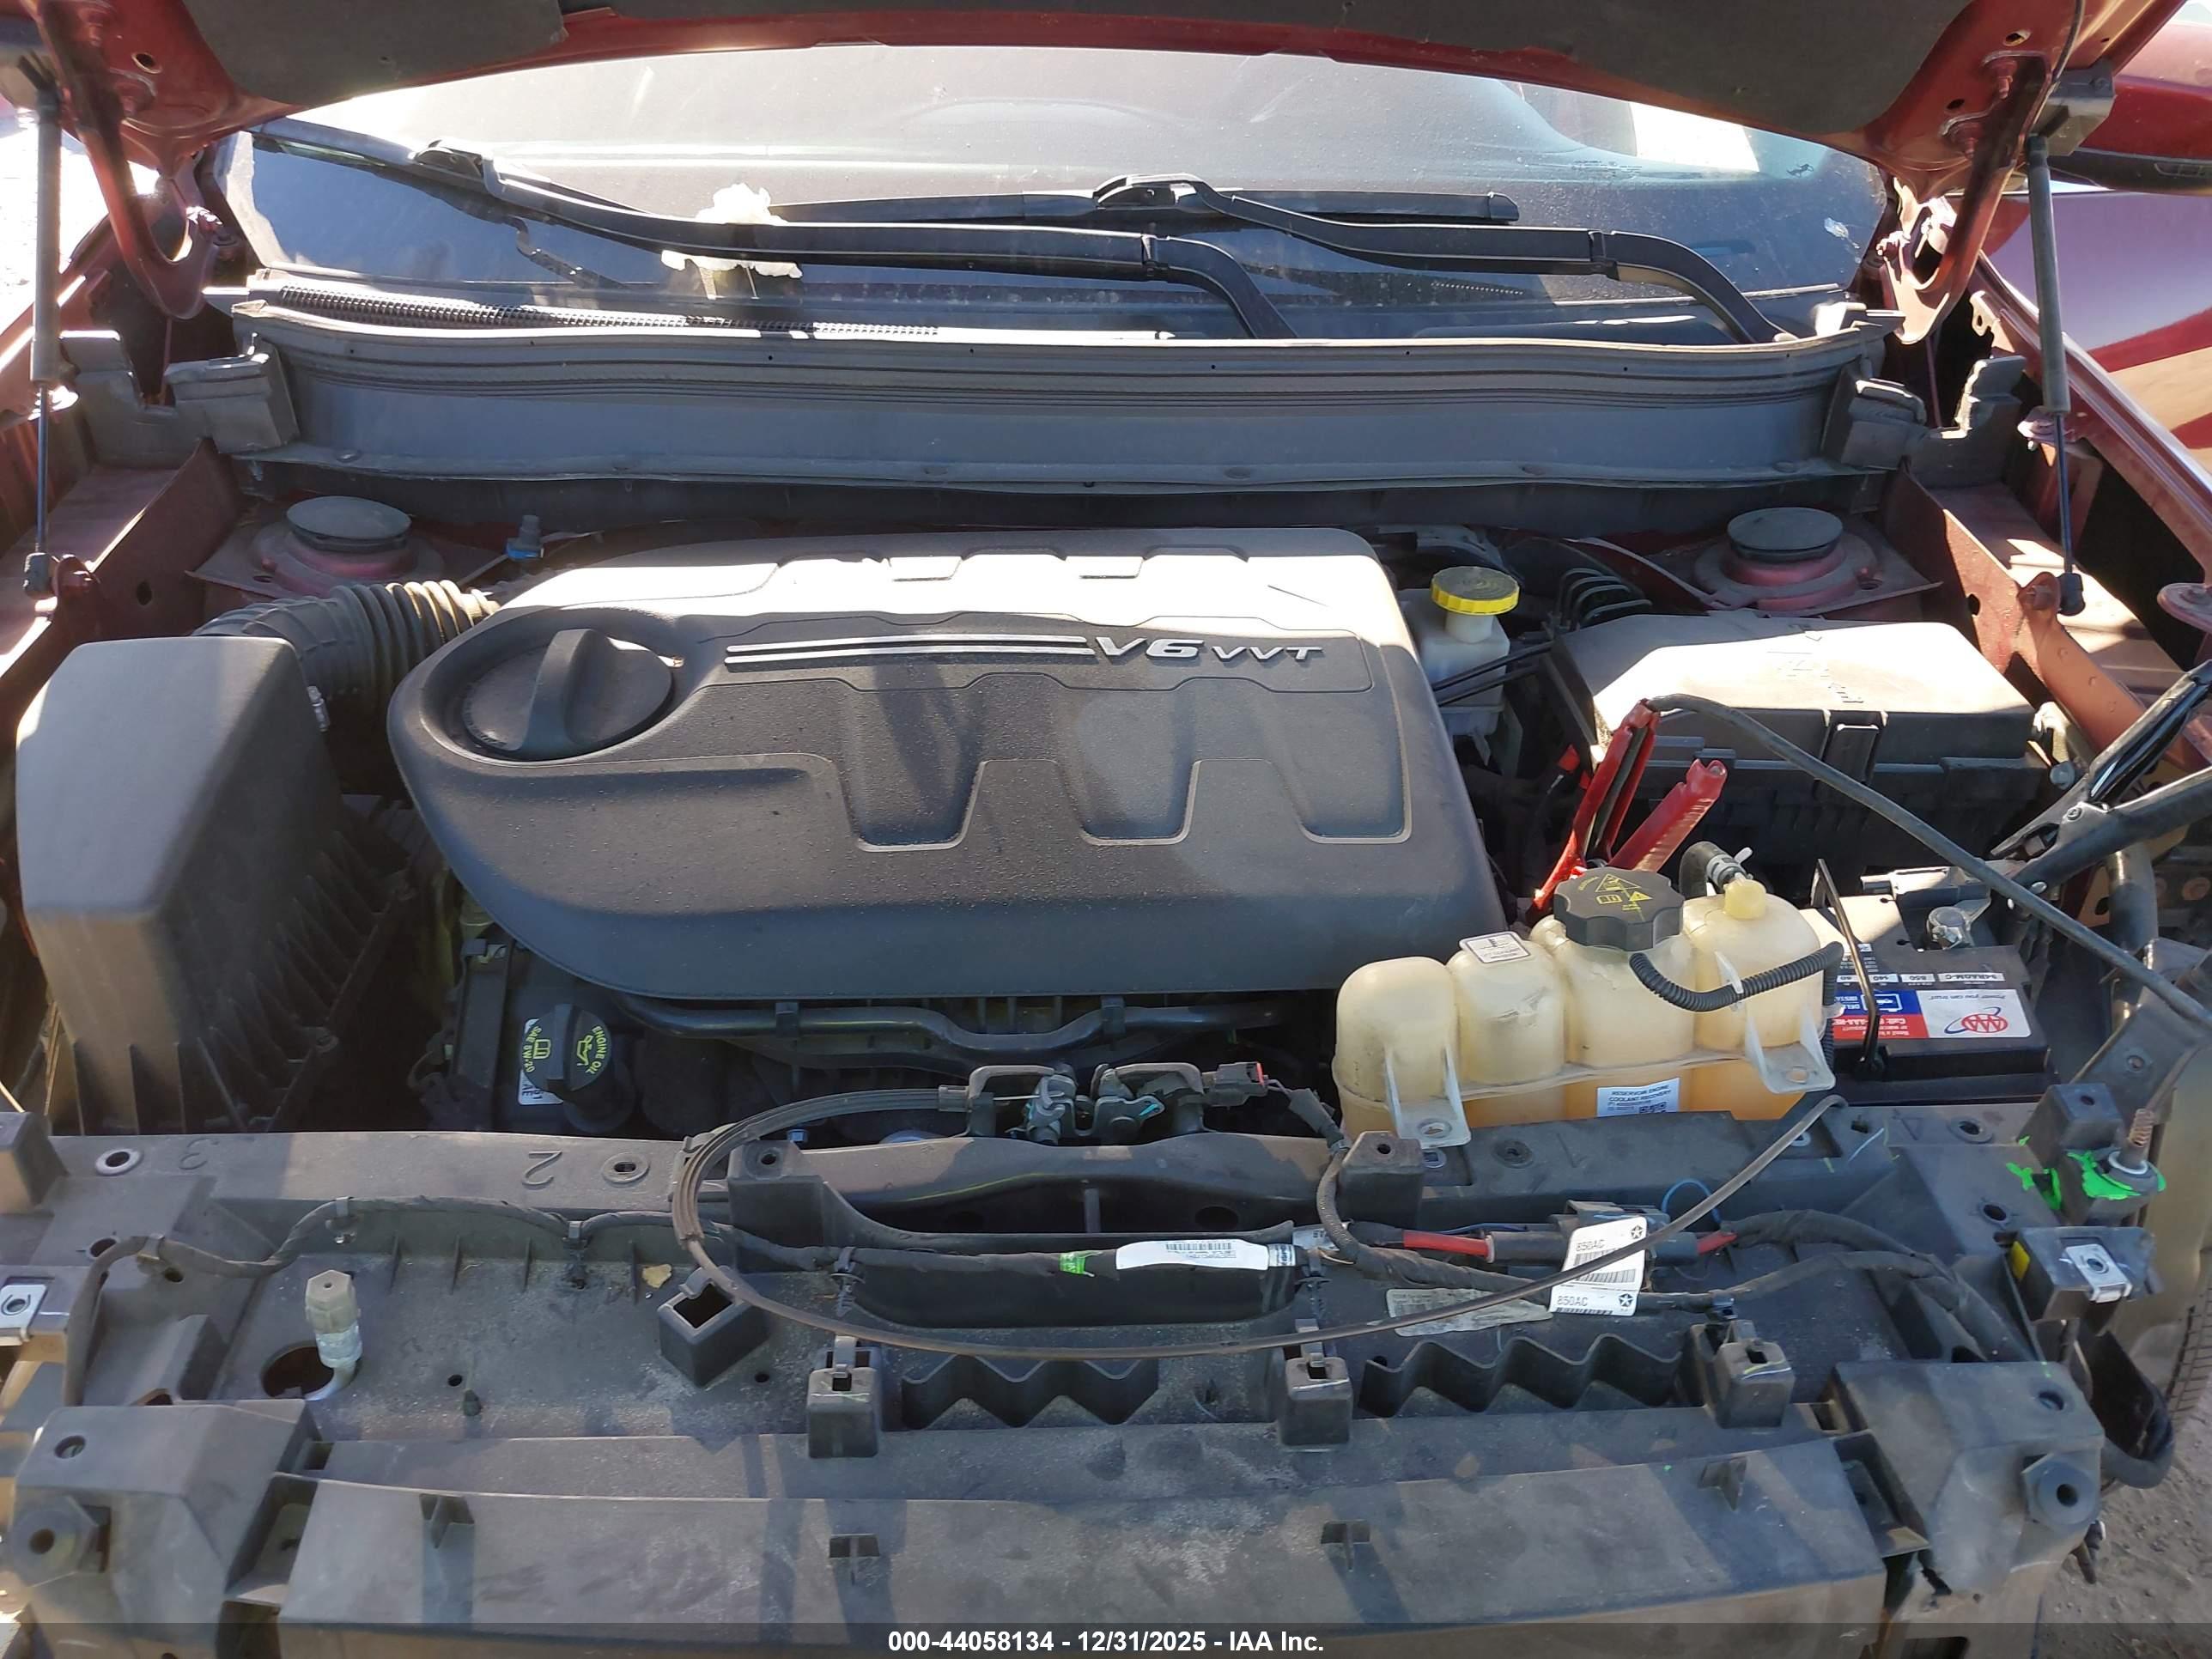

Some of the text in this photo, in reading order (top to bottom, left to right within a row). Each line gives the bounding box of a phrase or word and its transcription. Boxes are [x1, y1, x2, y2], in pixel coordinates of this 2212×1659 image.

[1096, 637, 1323, 660] V6 VVT
[1964, 1014, 2007, 1033] AAA
[526, 1026, 542, 1043] SAE
[586, 1026, 606, 1074] ENGINE OIL
